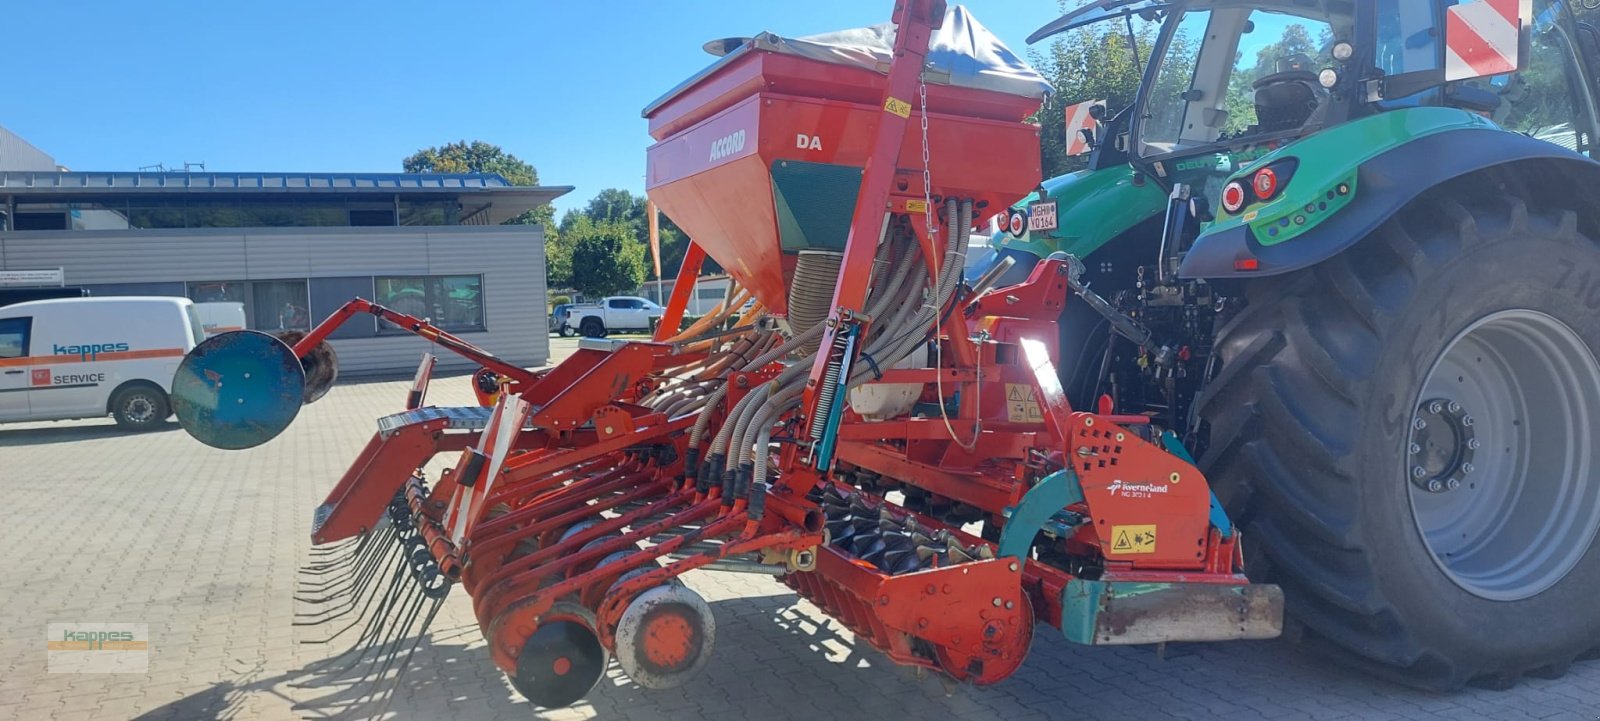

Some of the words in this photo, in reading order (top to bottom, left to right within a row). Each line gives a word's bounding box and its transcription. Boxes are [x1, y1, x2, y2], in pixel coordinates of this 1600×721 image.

[709, 129, 746, 162] ACCORD
[796, 133, 823, 151] DA
[53, 343, 129, 362] kappes
[53, 373, 105, 385] SERVICE
